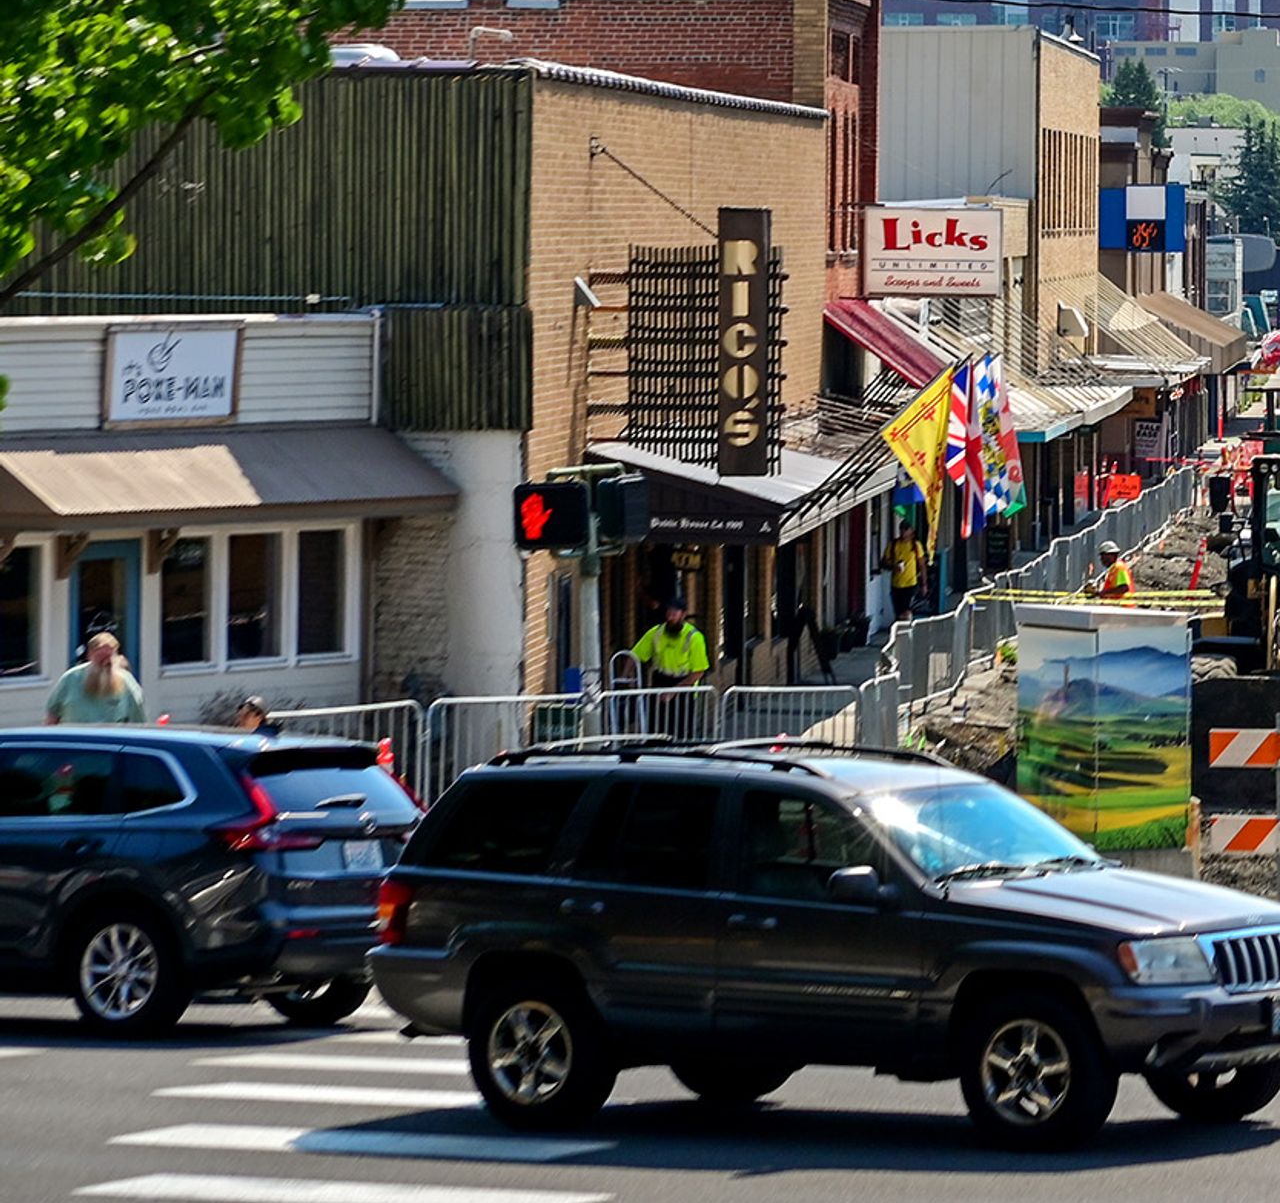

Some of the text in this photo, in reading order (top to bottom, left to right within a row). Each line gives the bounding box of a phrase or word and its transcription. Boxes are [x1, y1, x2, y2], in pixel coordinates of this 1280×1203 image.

[881, 217, 989, 251] Licks
[879, 262, 988, 270] UNLIMITED
[884, 275, 981, 289] Scoops and Sweets
[122, 375, 226, 404] POKE-MAN
